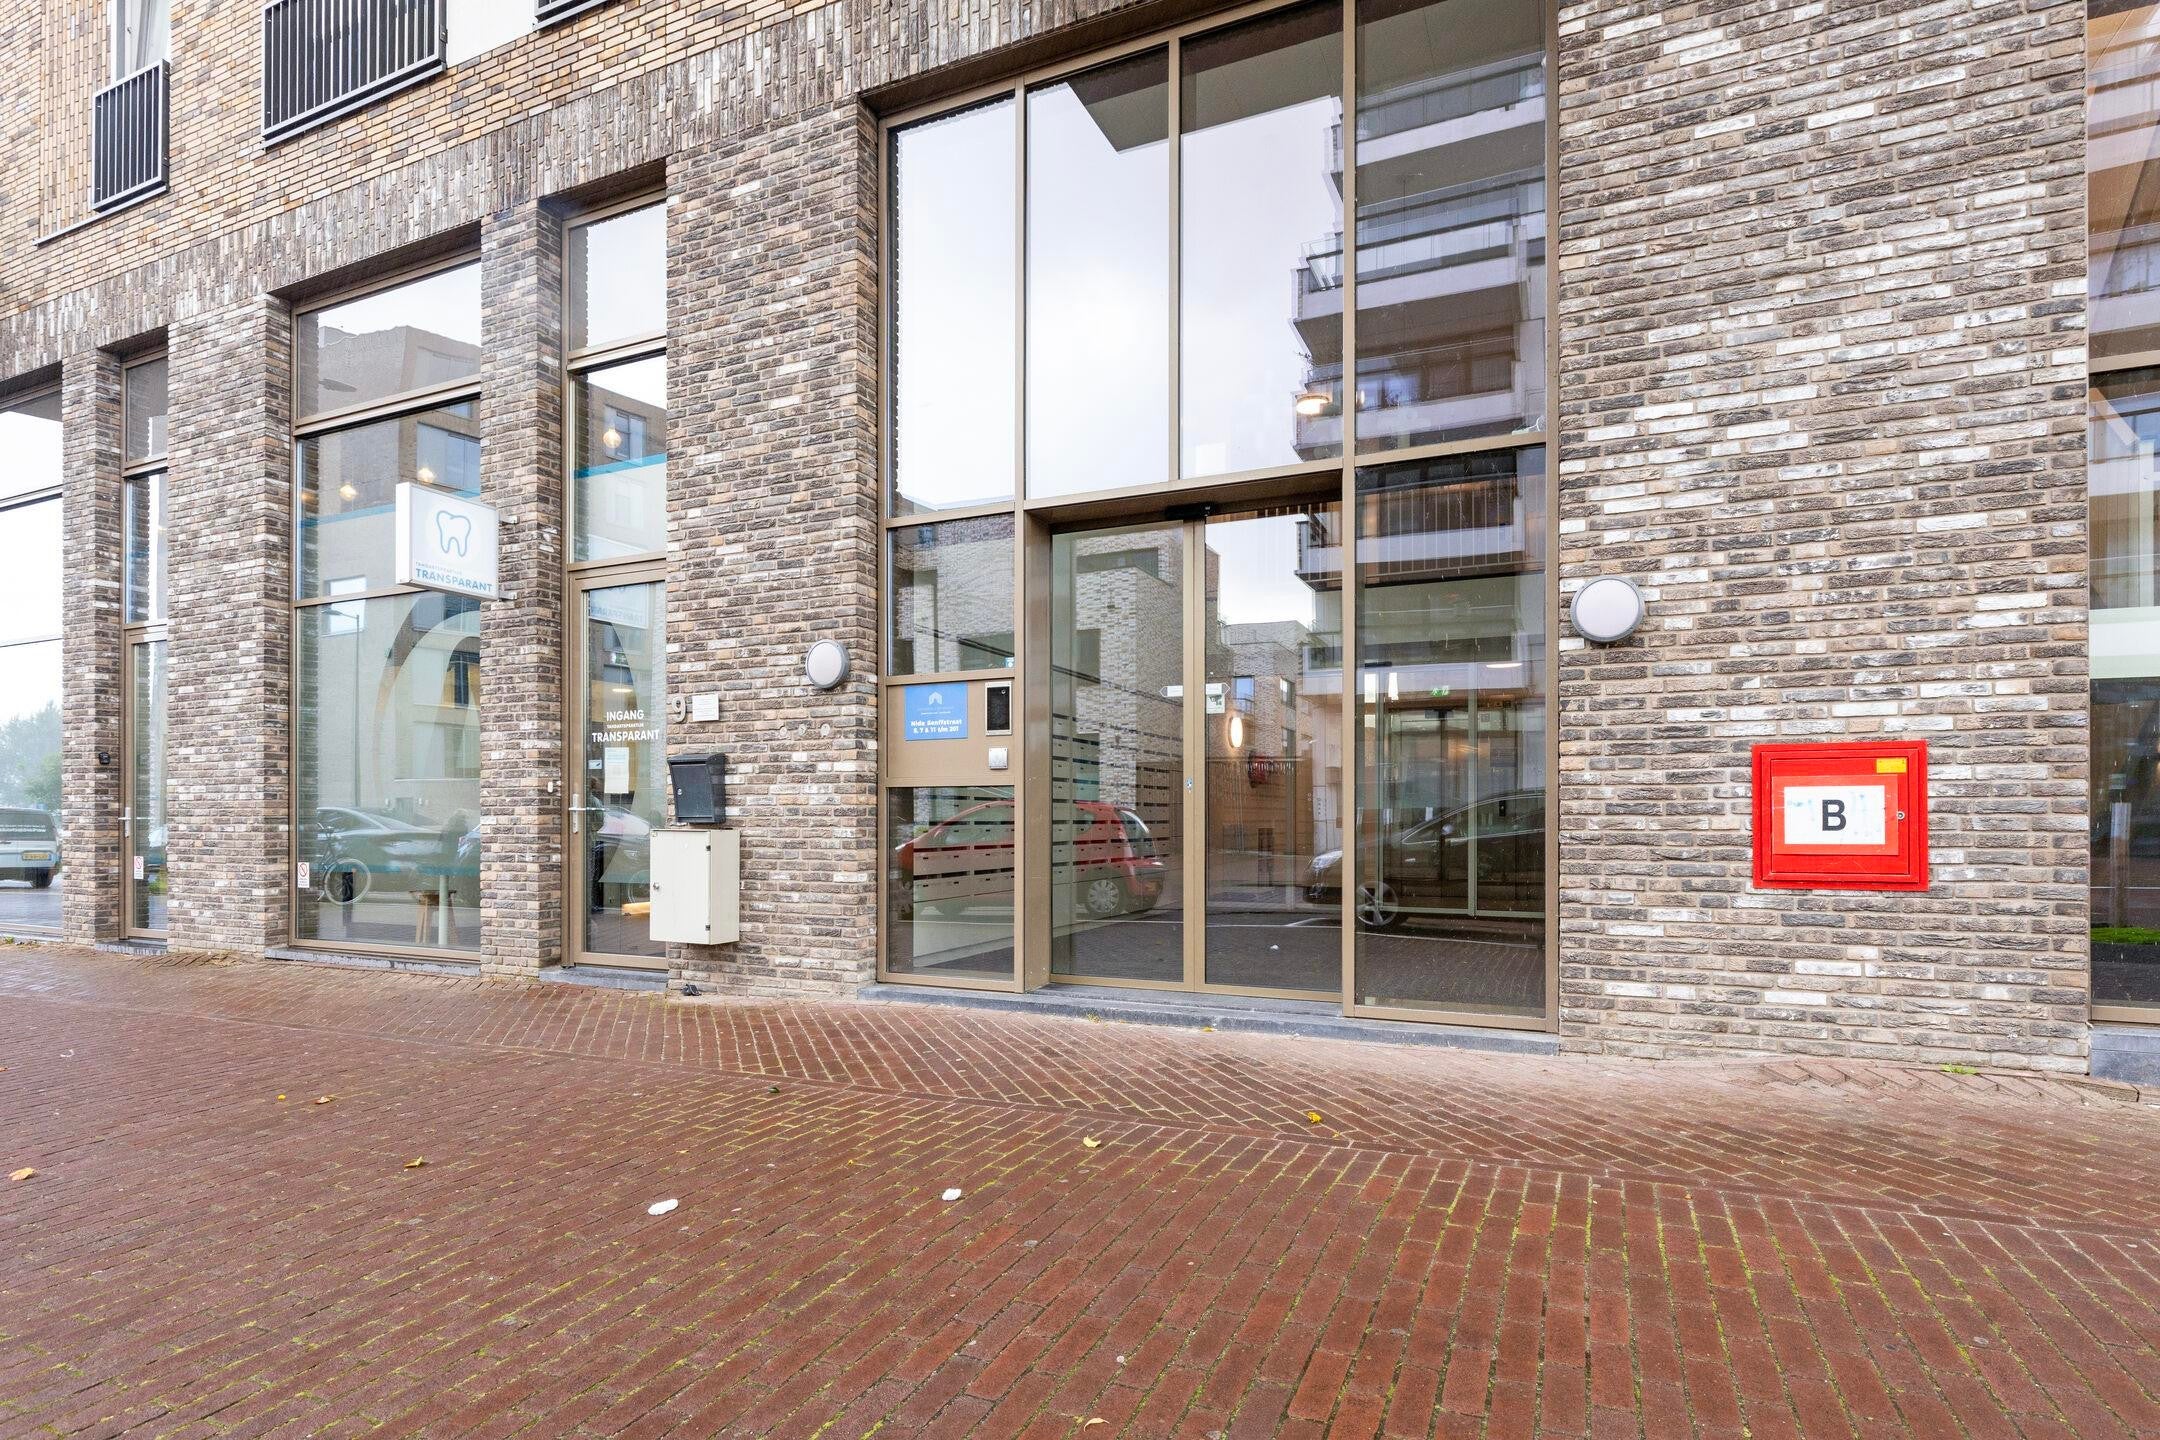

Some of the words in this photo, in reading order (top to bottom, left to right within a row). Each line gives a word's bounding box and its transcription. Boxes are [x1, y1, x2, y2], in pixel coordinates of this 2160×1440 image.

[416, 568, 493, 593] TRANSPARANT
[606, 710, 645, 722] INGANG
[671, 695, 686, 722] 9
[591, 729, 660, 743] TRANSPARANT
[1821, 799, 1847, 832] B
